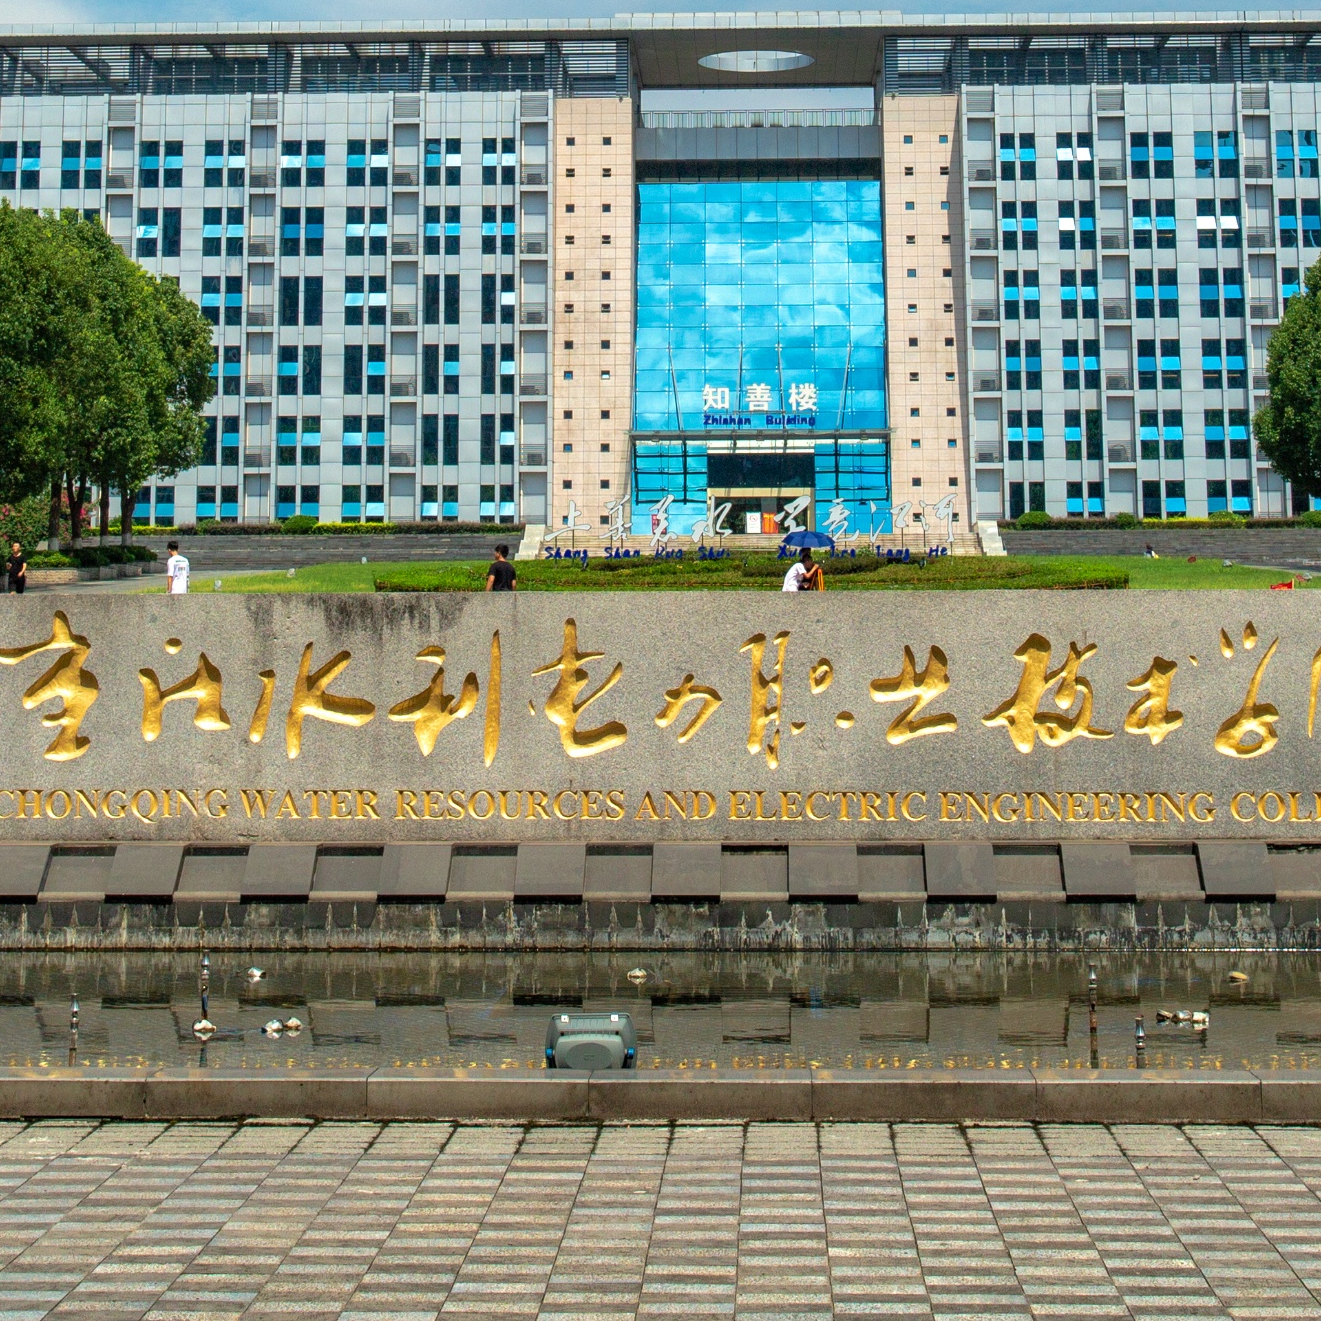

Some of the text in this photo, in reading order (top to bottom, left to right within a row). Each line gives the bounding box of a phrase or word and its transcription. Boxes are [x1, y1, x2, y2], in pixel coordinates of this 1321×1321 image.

[702, 383, 818, 412] 知善楼
[703, 414, 816, 427] Zhishan Building
[544, 546, 589, 564] Shang
[604, 546, 641, 559] Shan
[654, 545, 683, 560] Ruo
[927, 544, 948, 558] He
[240, 789, 380, 820] WATER
[394, 789, 626, 821] RESOURCES
[634, 790, 718, 822] AND
[727, 790, 927, 822] ELECTRIC
[938, 790, 1216, 823] ENGINEERING
